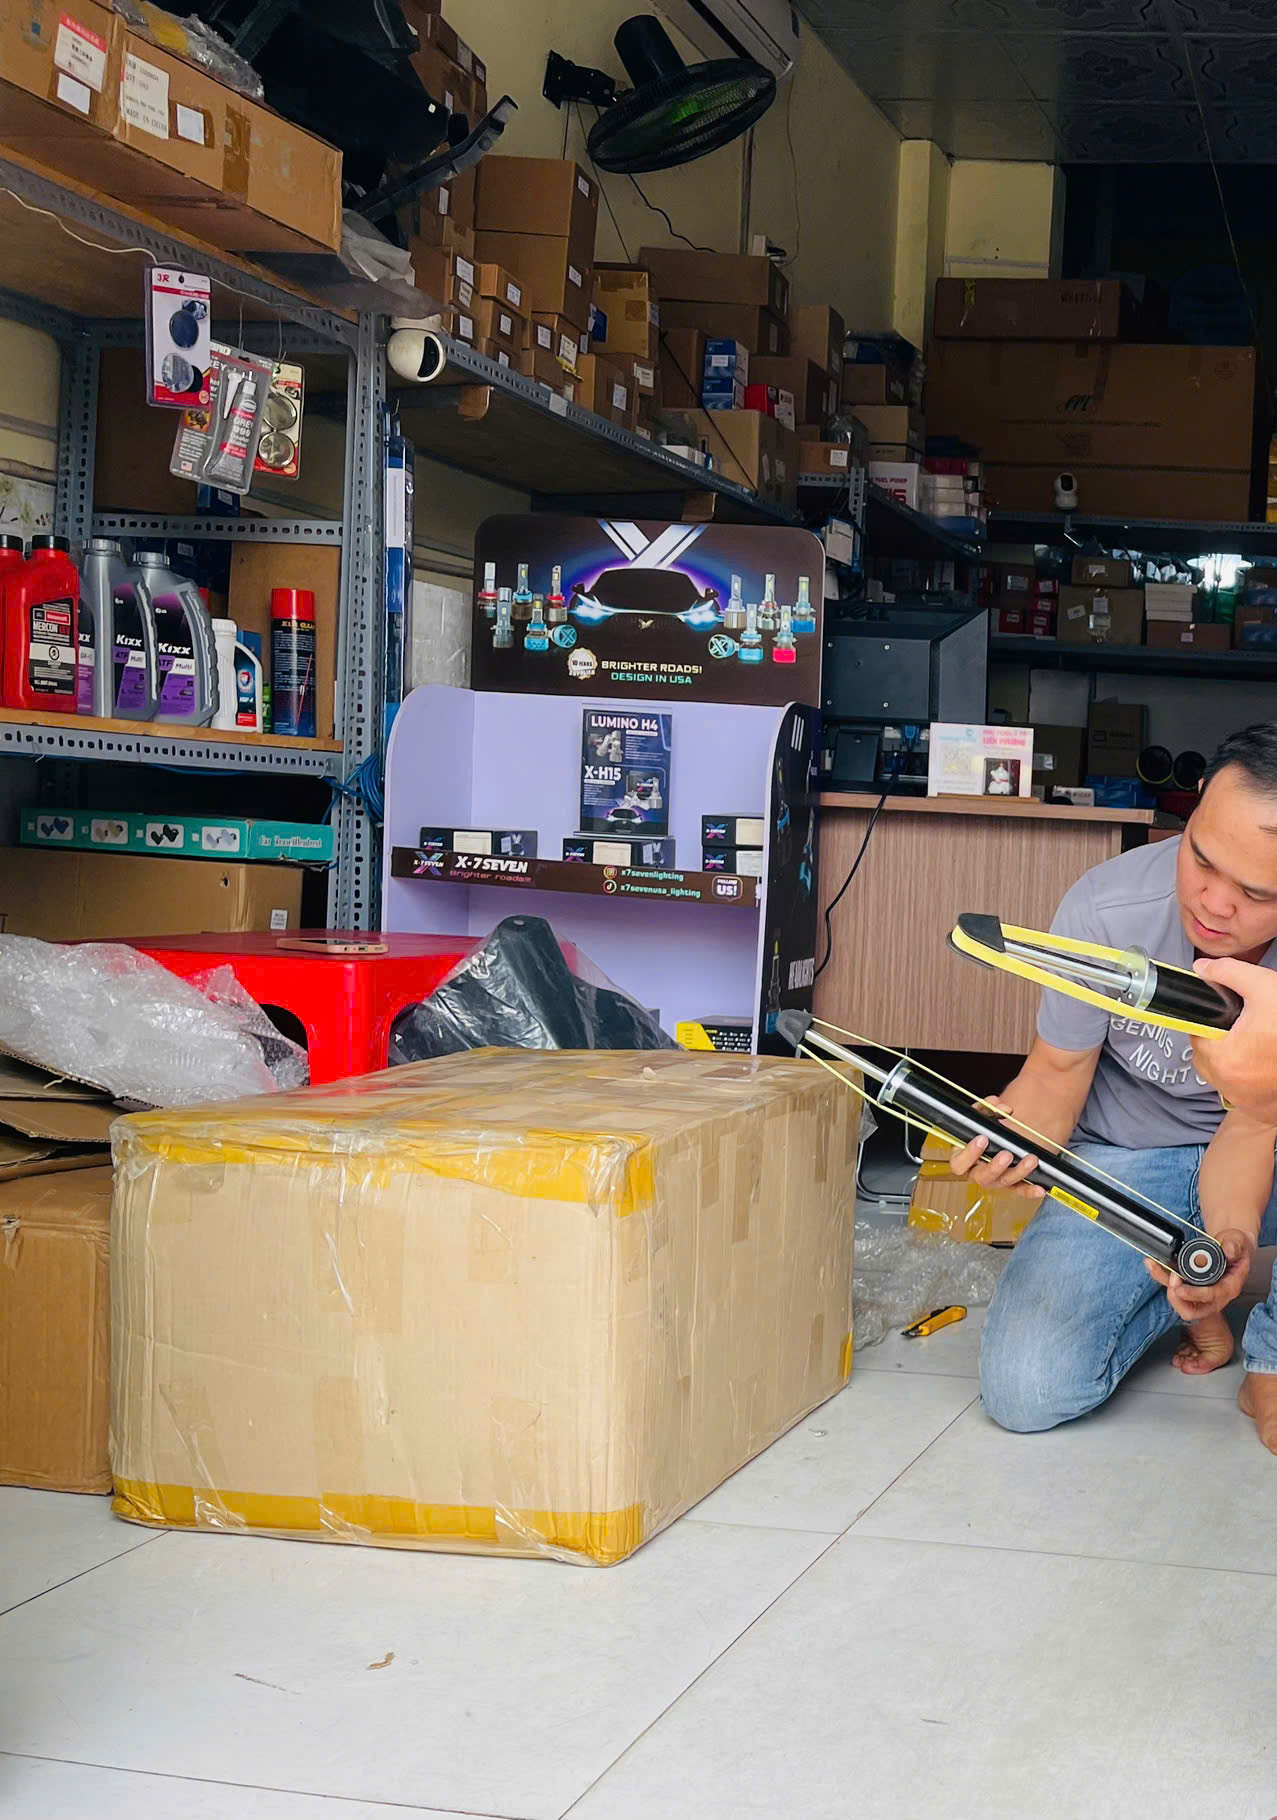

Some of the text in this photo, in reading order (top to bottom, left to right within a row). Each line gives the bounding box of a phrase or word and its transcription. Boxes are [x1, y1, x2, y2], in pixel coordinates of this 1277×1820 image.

[33, 620, 58, 633] MERCON
[116, 634, 142, 647] Kixx
[158, 643, 191, 655] Kixx
[601, 660, 703, 674] BRIGHTER ROADS!
[611, 672, 692, 684] DESIGN IN USA
[591, 715, 659, 731] LUMINO H4
[584, 765, 622, 781] X-H15
[455, 855, 529, 874] X-7SEVEN
[450, 869, 492, 880] Brighter
[716, 884, 737, 897] US!
[1110, 1017, 1173, 1058] GENIUS
